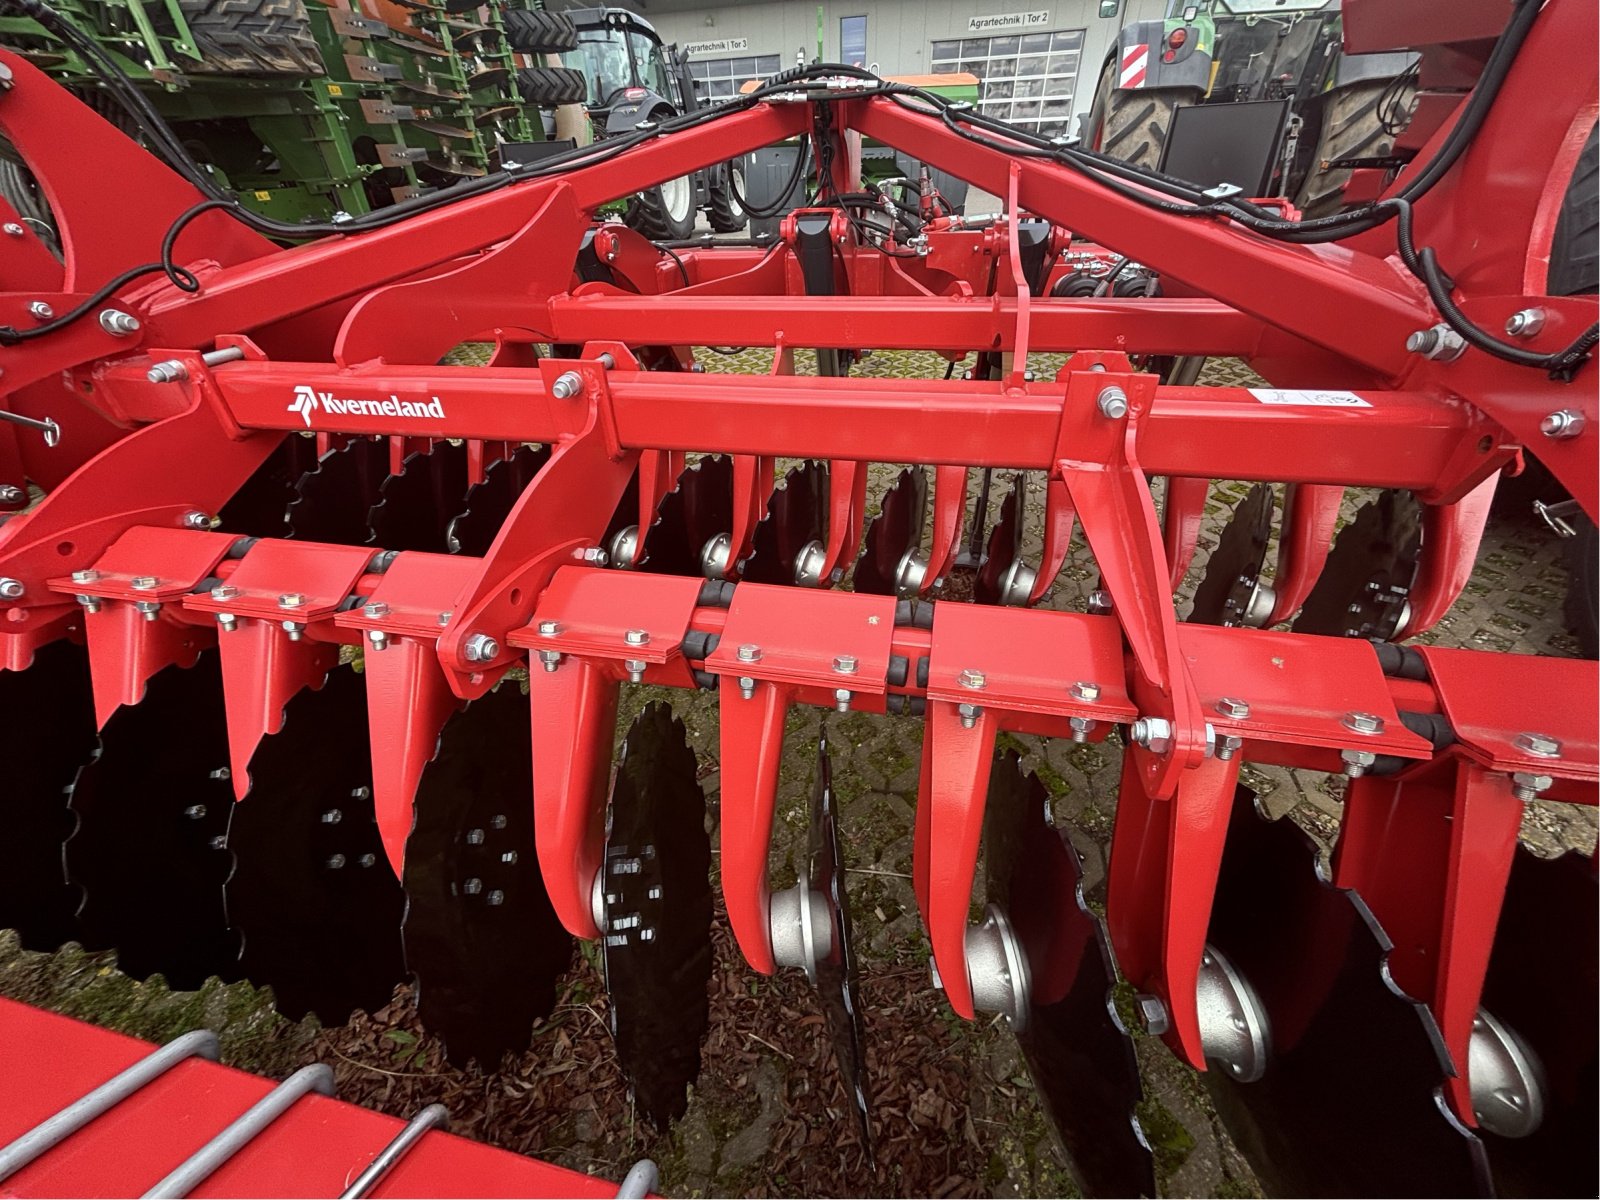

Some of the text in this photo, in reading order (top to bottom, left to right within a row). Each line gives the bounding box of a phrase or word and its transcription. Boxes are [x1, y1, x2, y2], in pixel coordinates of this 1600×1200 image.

[970, 15, 1020, 29] Agrartechnik
[1027, 14, 1041, 23] Tor
[1042, 12, 1048, 22] 2
[686, 41, 725, 53] Agrartechnik
[731, 41, 741, 49] Tor
[742, 39, 747, 48] 3
[318, 392, 446, 418] Kverneland
